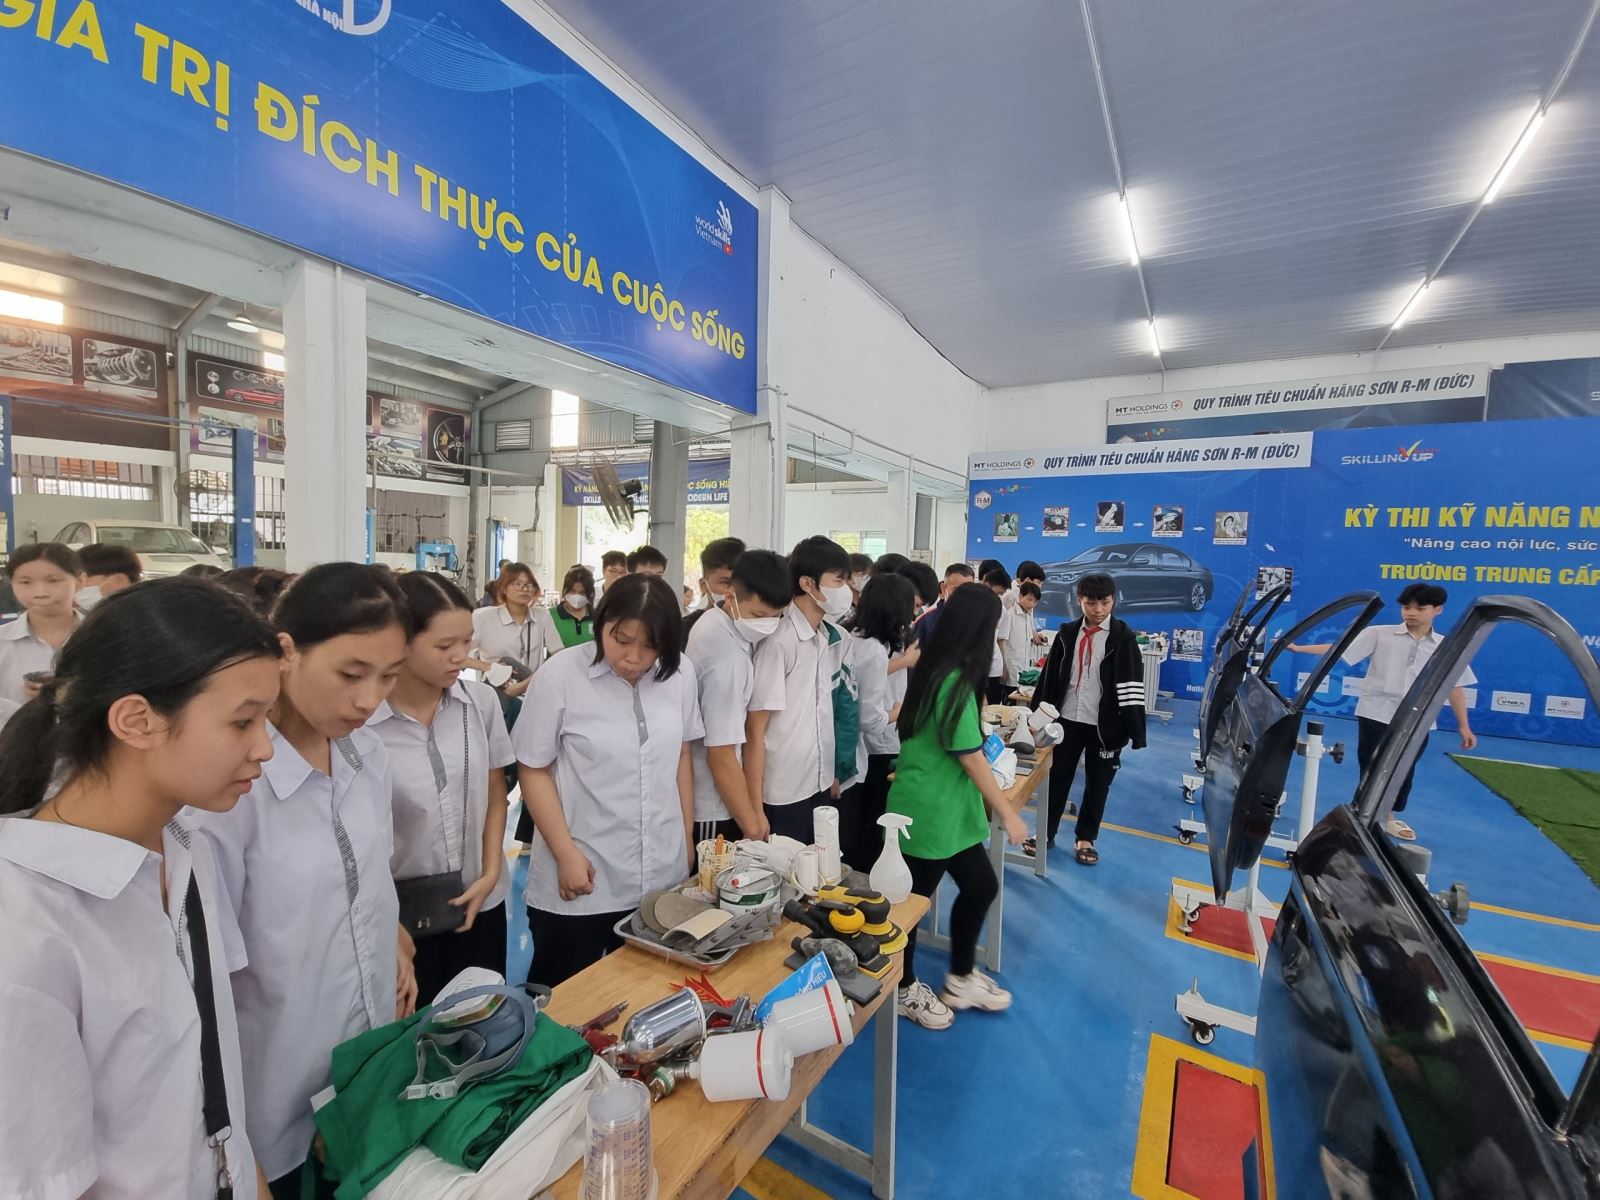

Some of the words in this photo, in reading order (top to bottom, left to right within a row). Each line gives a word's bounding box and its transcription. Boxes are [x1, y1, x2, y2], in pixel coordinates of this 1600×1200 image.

[134, 22, 230, 132] TRỊ
[254, 81, 399, 197] ĐÍCH
[414, 163, 525, 251] THỰC
[535, 232, 604, 294] CỦA
[612, 271, 686, 331] CUỘC
[691, 309, 746, 360] SỐNG
[1193, 398, 1217, 412] QUY
[1218, 392, 1252, 409] TRÌNH
[1255, 389, 1281, 405] TIÊU
[1283, 383, 1327, 403] CHUẨN
[1328, 383, 1367, 399] HÃNG
[1368, 379, 1399, 396] SƠN
[1400, 377, 1431, 393] R-M
[1433, 372, 1475, 392] (ĐỨC)
[1130, 403, 1169, 413] HOLDINGS
[987, 460, 1022, 468] HOLDINGS
[1043, 456, 1065, 470] QUY
[1066, 453, 1098, 468] TRÌNH
[1099, 451, 1122, 466] TIÊU
[1124, 446, 1164, 465] CHUẨN
[1165, 447, 1200, 462] HÃNG
[1202, 446, 1230, 461] SƠN
[1231, 446, 1259, 461] R-M
[1261, 442, 1301, 461] (ĐỨC)
[583, 495, 602, 504] SKILLS
[687, 493, 712, 502] ODERN
[714, 492, 728, 501] LIFE
[1344, 503, 1380, 528] KỲ
[1387, 507, 1431, 528] THI
[1438, 502, 1478, 528] KỸ
[1485, 501, 1571, 528] NĂNG
[1460, 540, 1492, 549] cao
[1496, 538, 1524, 551] nội
[1530, 539, 1561, 552] lực,
[1566, 539, 1599, 551] sức
[1380, 561, 1468, 581] TRƯỜNG
[1474, 566, 1552, 584] TRUNG
